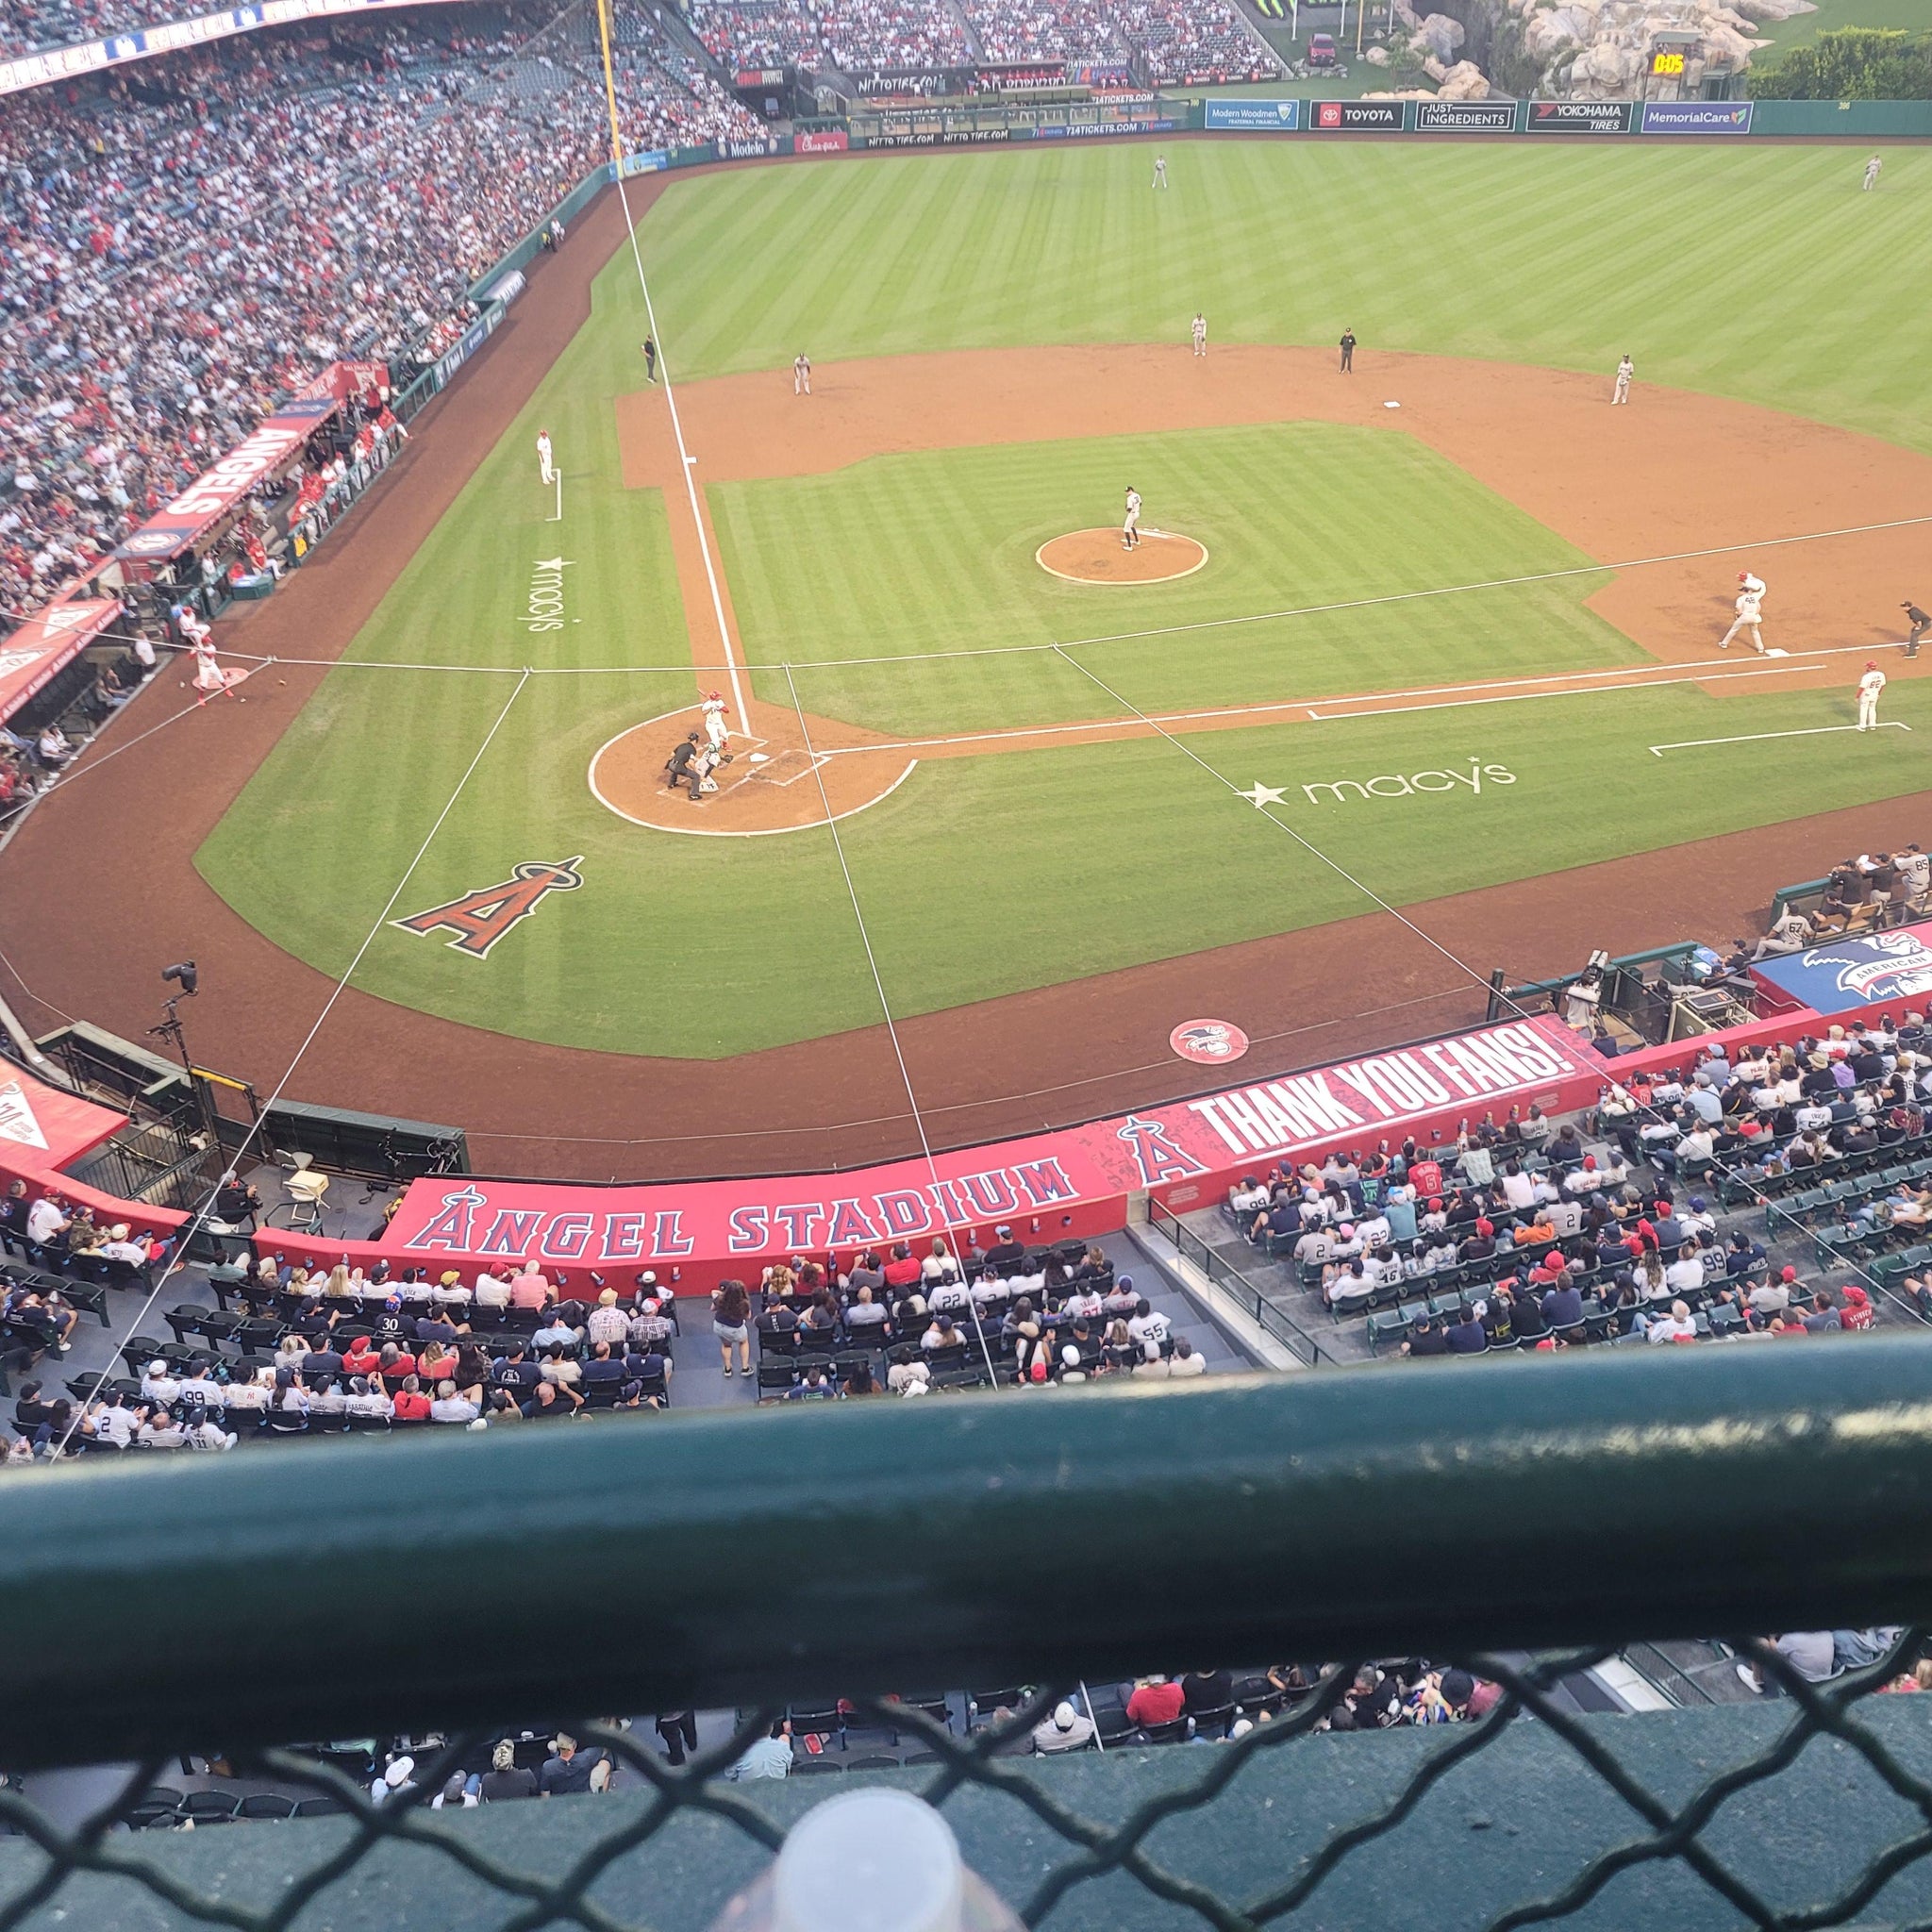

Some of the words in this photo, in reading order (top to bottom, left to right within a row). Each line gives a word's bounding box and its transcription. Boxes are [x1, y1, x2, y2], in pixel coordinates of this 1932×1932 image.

[1212, 108, 1241, 118] Modern
[1241, 108, 1277, 118] Woodmen
[1345, 109, 1393, 121] TOYOTA
[1426, 104, 1453, 113] JUST
[1557, 105, 1621, 117] YOKOHAMA
[1426, 113, 1505, 125] INGREDIENTS
[1649, 111, 1730, 124] MemorialCare
[1066, 123, 1138, 136] 714TICKETS.COM
[1590, 121, 1620, 130] TIRES
[869, 137, 893, 147] NITTO
[896, 134, 934, 146] TIRE.COM
[943, 133, 968, 143] NITTO
[970, 129, 1008, 141] TIRE.COM
[730, 142, 765, 158] Modelo
[166, 427, 299, 515] ANGELS
[1915, 859, 1929, 872] 85
[1789, 922, 1803, 934] 67
[1856, 956, 1926, 980] AMERICAN
[1188, 1073, 1366, 1156] THANK
[1332, 1051, 1451, 1118] YOU
[1421, 1023, 1575, 1096] FANS!
[404, 1185, 694, 1261] ANGEL
[728, 1157, 1081, 1254] STADIUM
[1566, 1213, 1575, 1228] 2
[1316, 1243, 1325, 1258] 2
[1702, 1252, 1725, 1273] 99
[942, 1293, 960, 1307] 22
[382, 1317, 399, 1331] 30
[1142, 1324, 1163, 1341] 55
[185, 1391, 205, 1405] 99
[101, 1416, 111, 1433] 2
